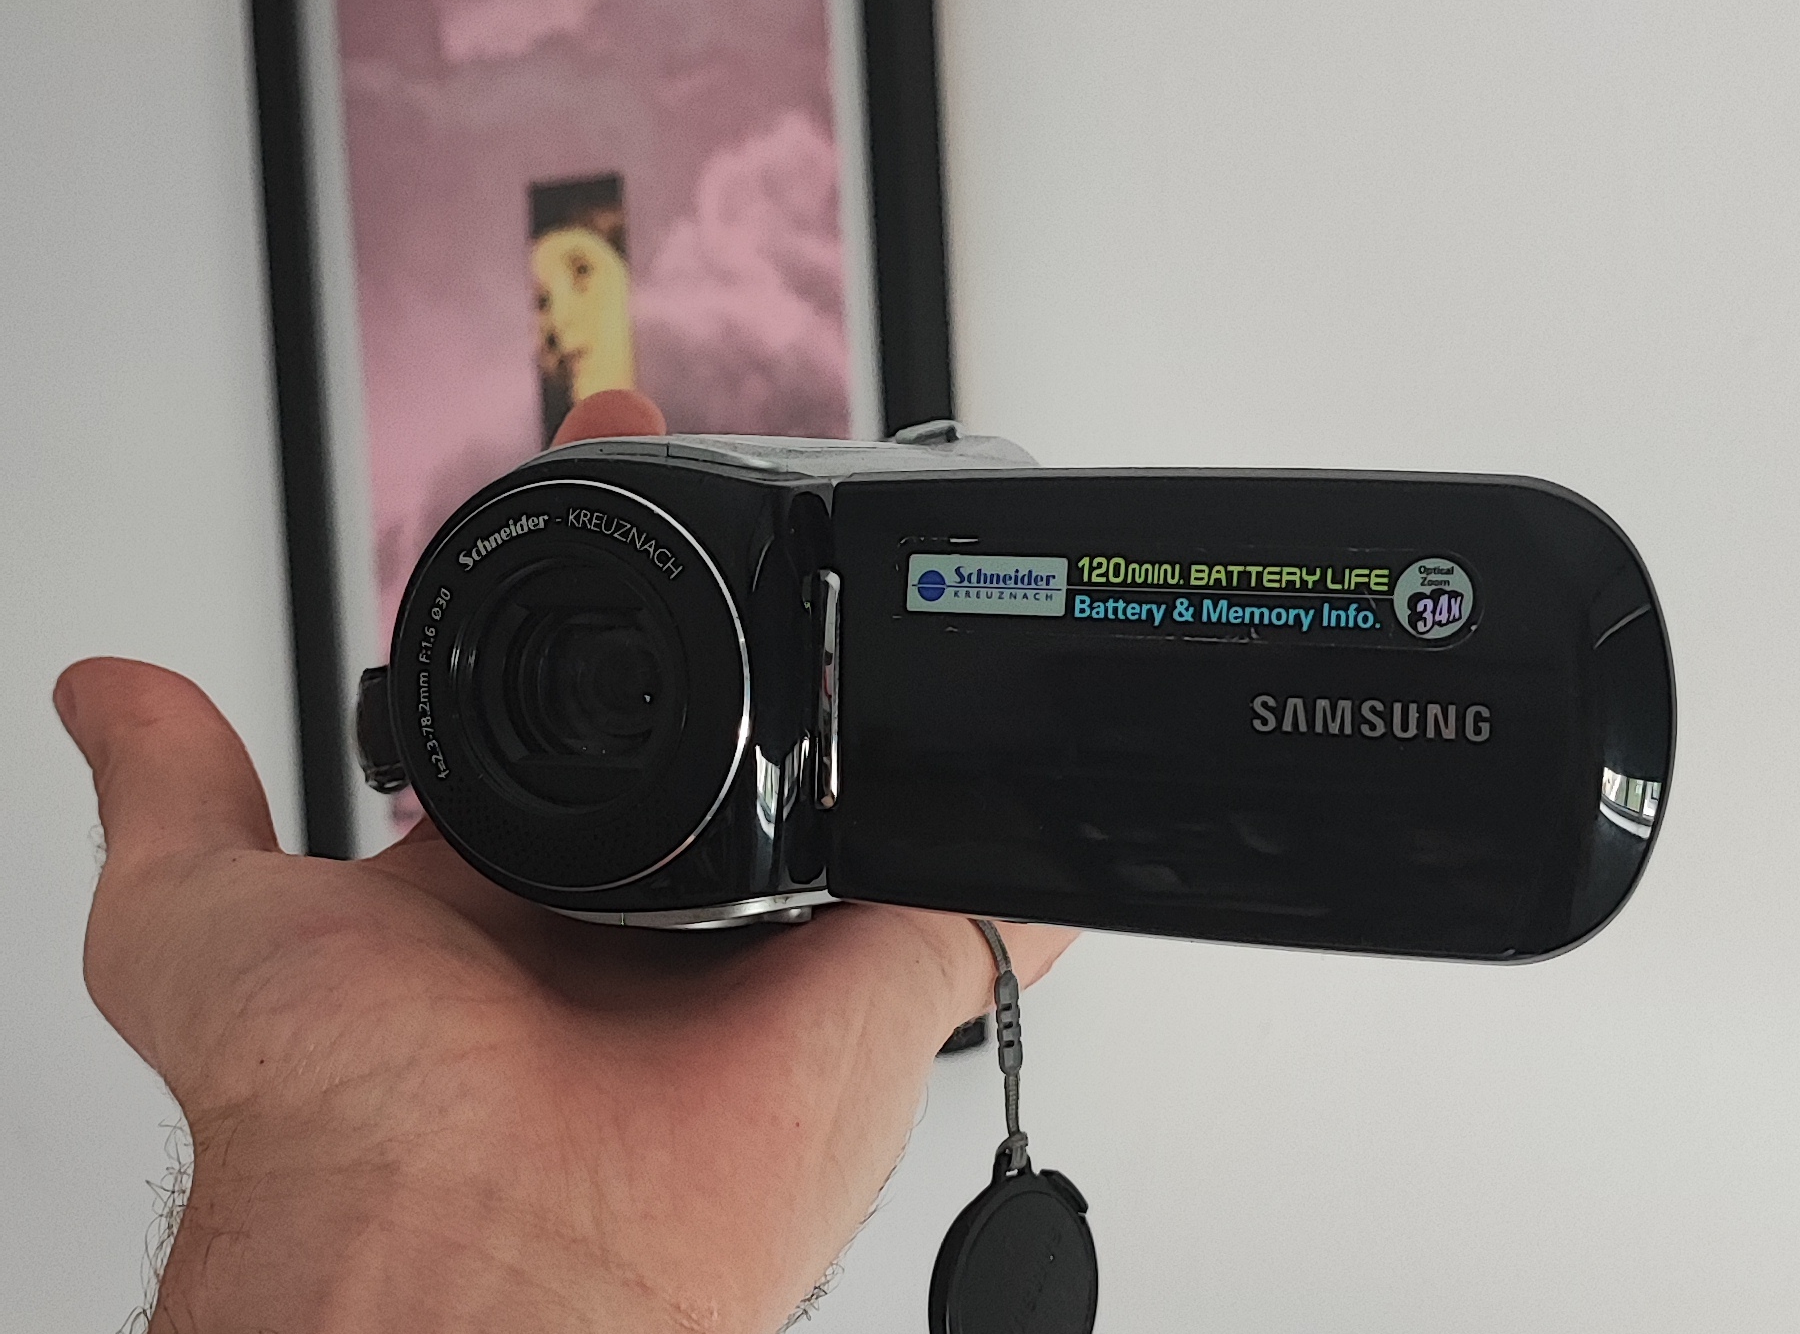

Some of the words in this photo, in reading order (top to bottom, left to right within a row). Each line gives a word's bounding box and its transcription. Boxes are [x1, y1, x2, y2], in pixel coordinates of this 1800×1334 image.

[458, 514, 549, 571] Schneider
[568, 508, 683, 579] KREUZNACH
[954, 566, 1056, 587] Schneider
[1190, 565, 1321, 590] BATTERY
[1327, 568, 1390, 591] LIFE
[1418, 565, 1455, 575] Optical
[1420, 577, 1450, 587] Zoom
[953, 589, 1053, 602] KREUZNACH
[1074, 595, 1166, 626] Battery
[1172, 597, 1195, 622] &
[1202, 598, 1315, 632] Memory
[1322, 602, 1382, 629] Info.
[1251, 694, 1491, 743] SAMSUNG
